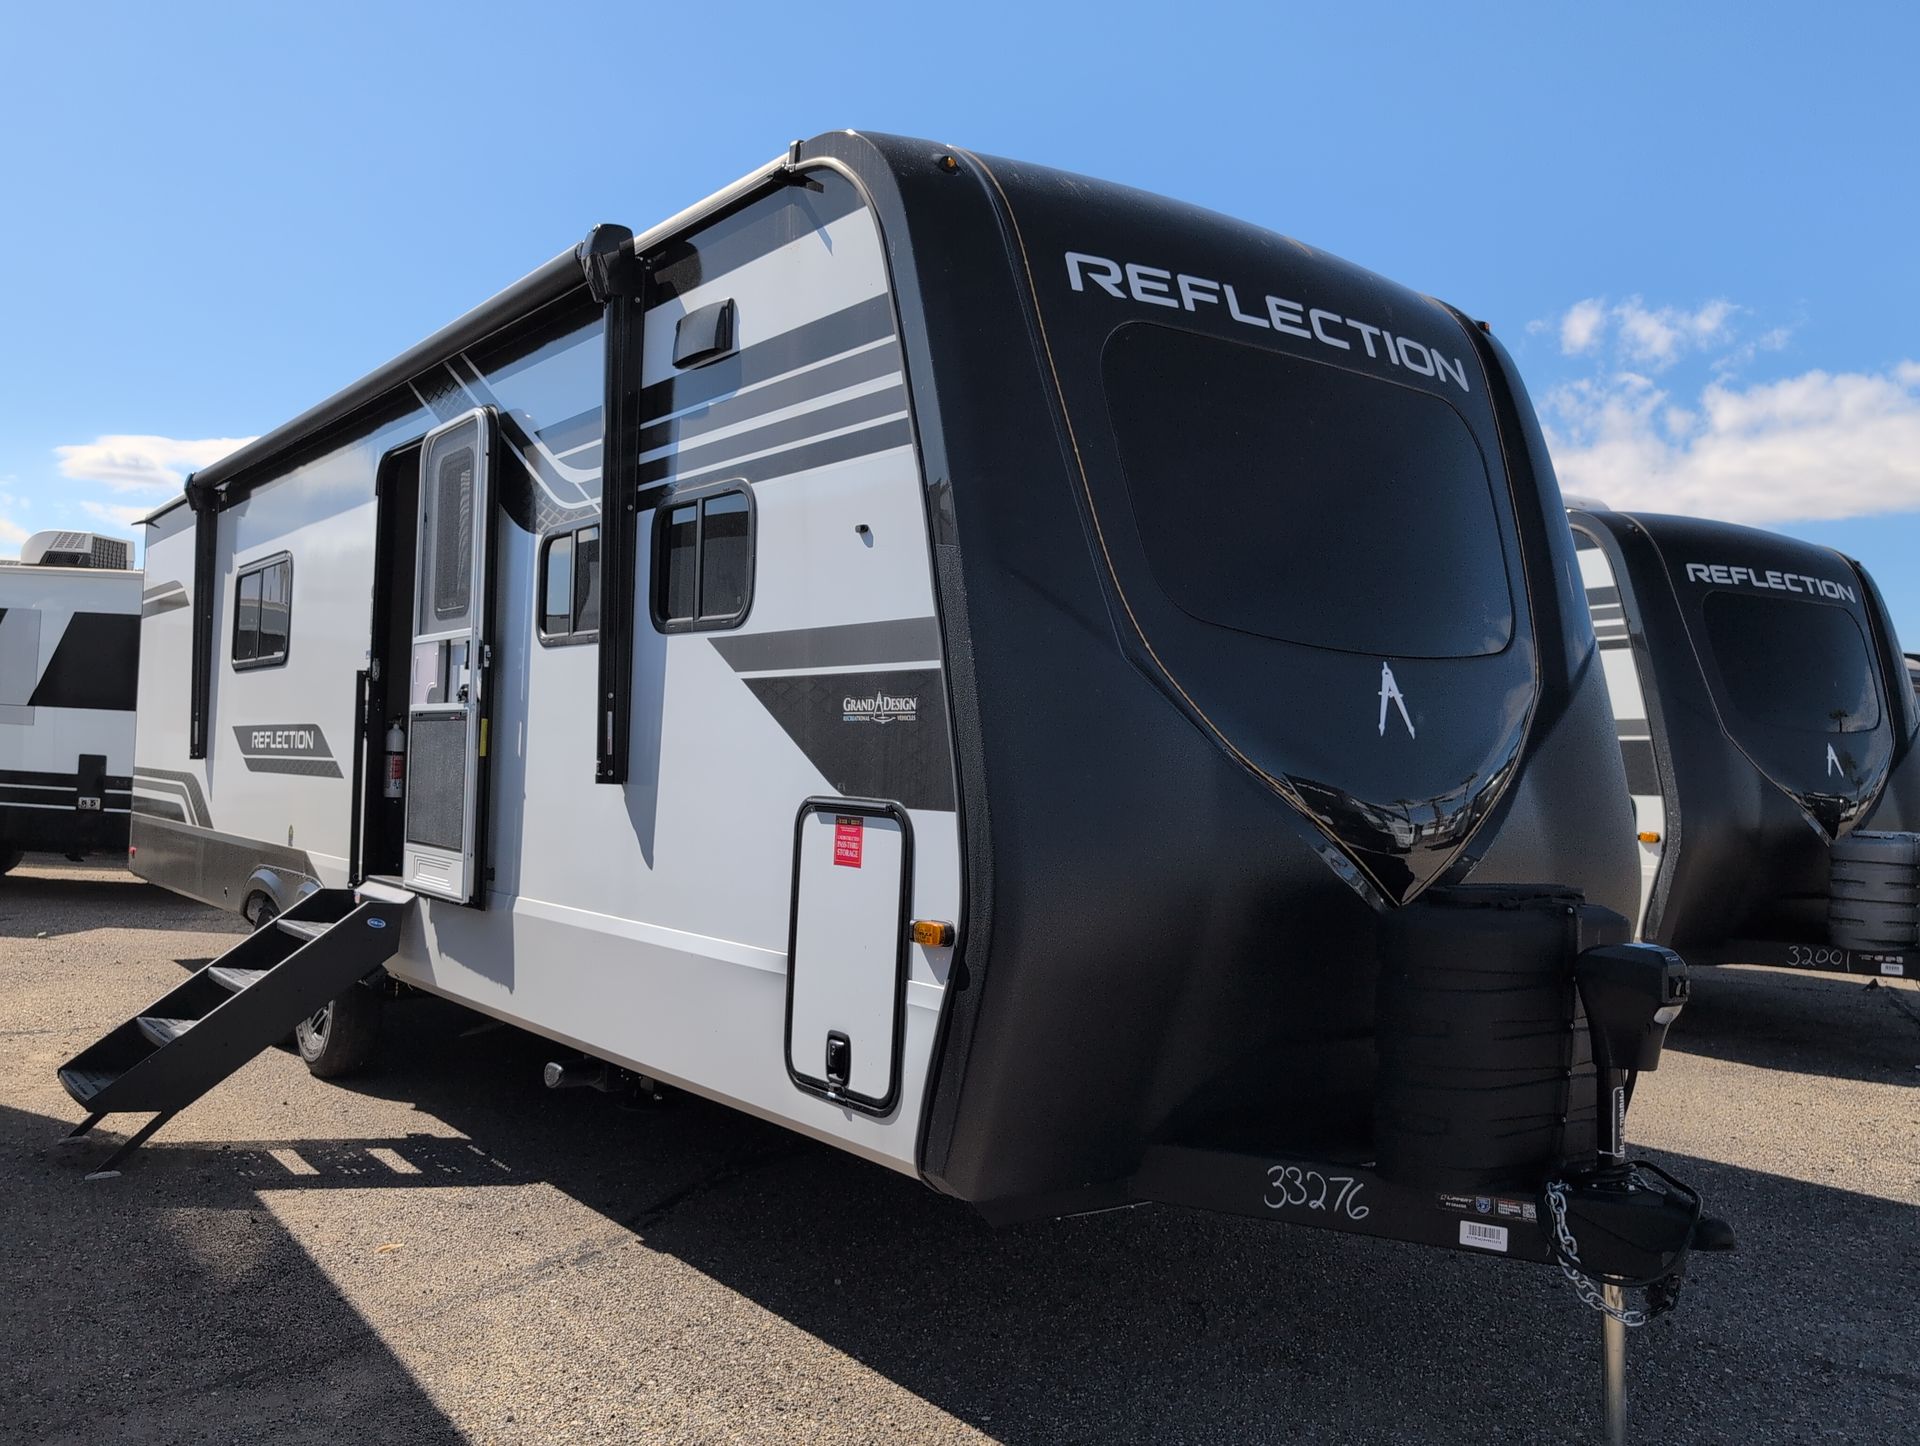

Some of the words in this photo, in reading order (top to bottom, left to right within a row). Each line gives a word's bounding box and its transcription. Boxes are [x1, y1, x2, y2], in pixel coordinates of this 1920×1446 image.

[1064, 250, 1470, 393] REFLECTION
[1686, 562, 1856, 603] REFLECTION
[843, 697, 874, 711] GRAND
[883, 696, 917, 711] DESIGN
[251, 730, 314, 749] REFLECTION
[837, 848, 858, 857] STORAGE
[1786, 945, 1850, 972] 32001
[1263, 1164, 1370, 1220] 33276
